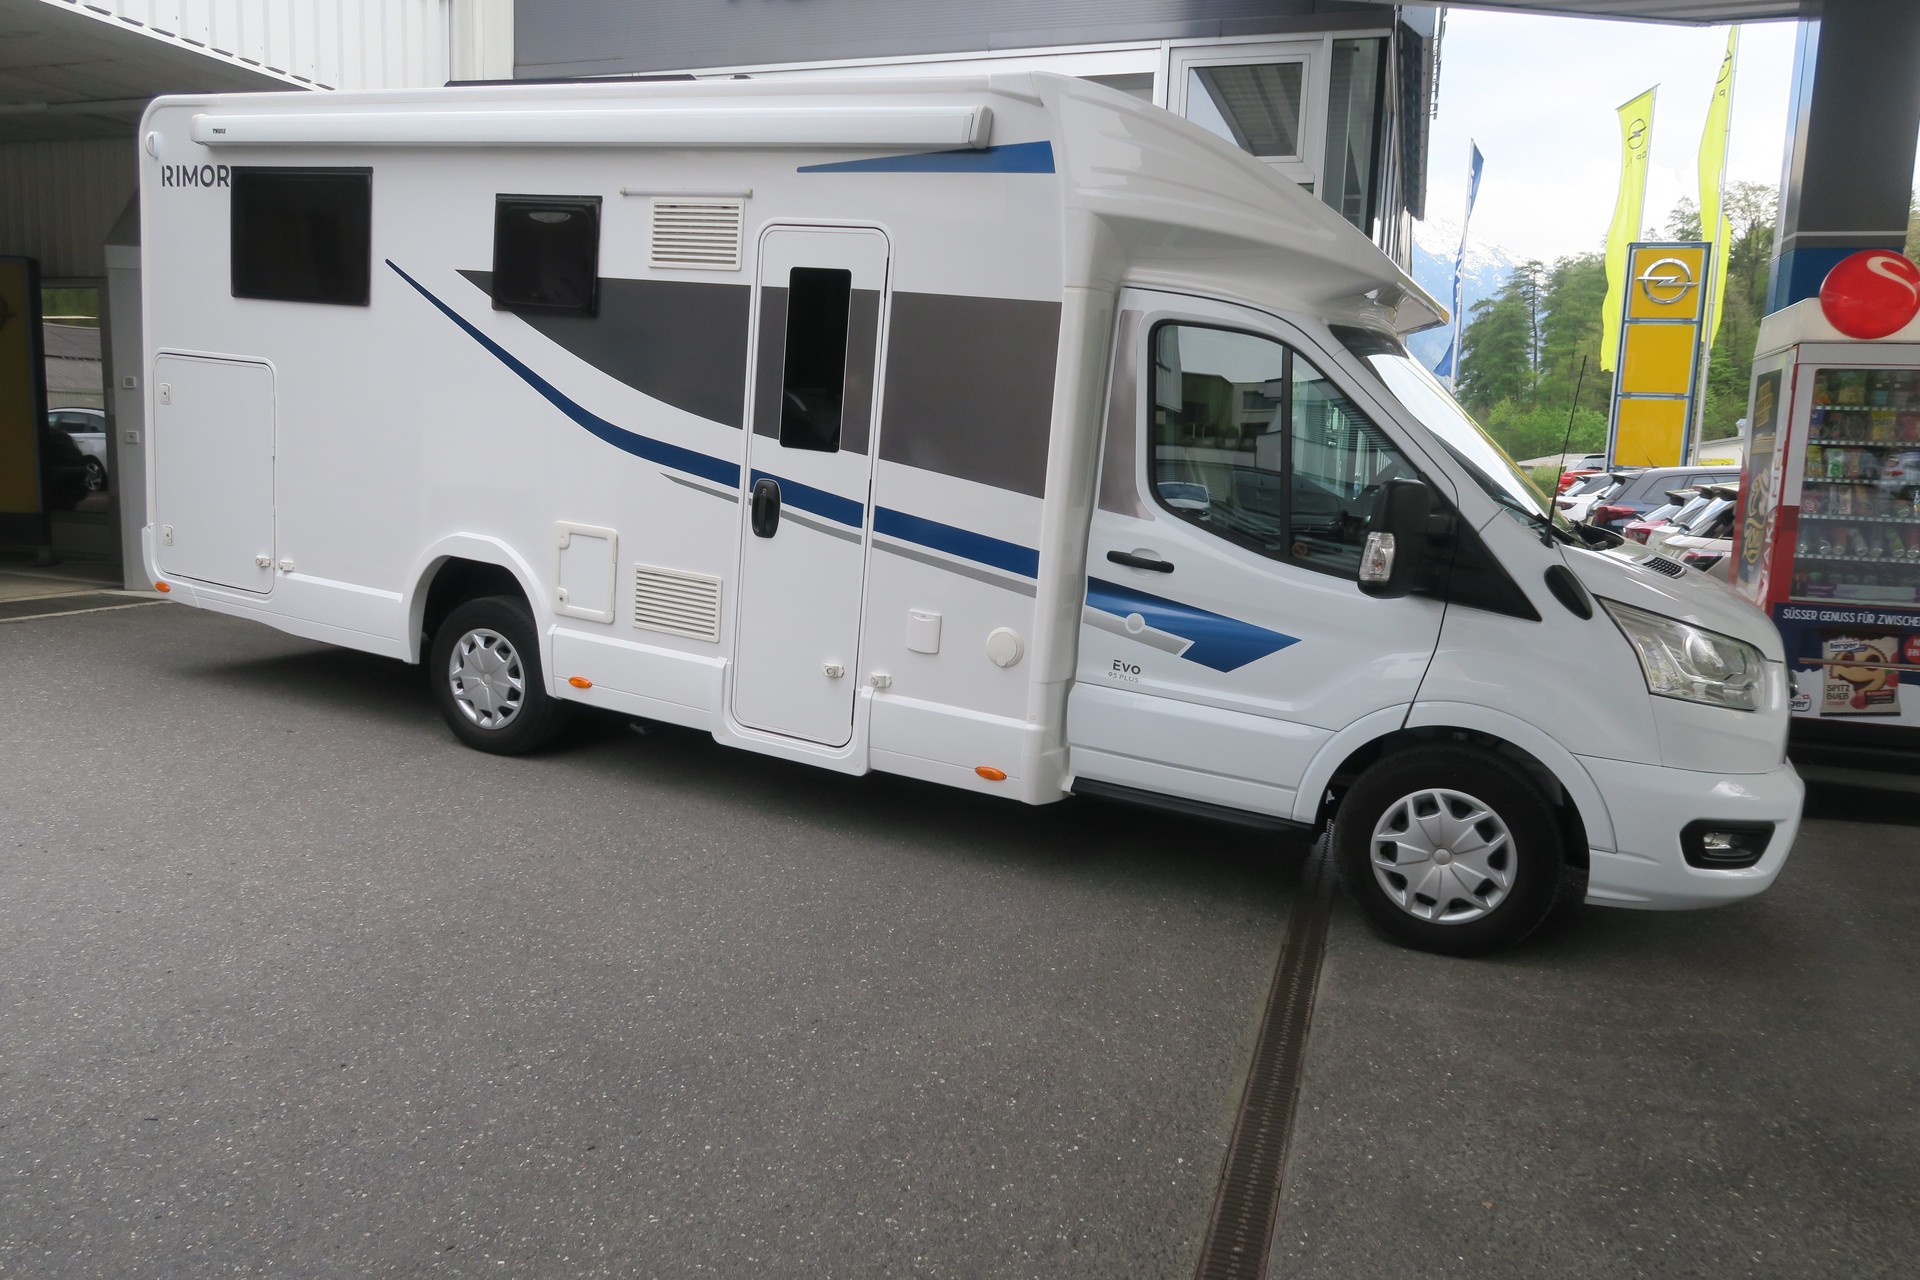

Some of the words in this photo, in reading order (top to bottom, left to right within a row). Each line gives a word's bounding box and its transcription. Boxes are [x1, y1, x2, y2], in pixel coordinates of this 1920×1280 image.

[161, 164, 230, 188] RIMOR
[1783, 607, 1817, 620] SÜSSER
[1819, 610, 1856, 623] GENUSS
[1857, 611, 1876, 625] FÜR
[1119, 674, 1139, 683] PLUS
[1827, 684, 1850, 692] SPITZ
[1790, 700, 1808, 709] ger
